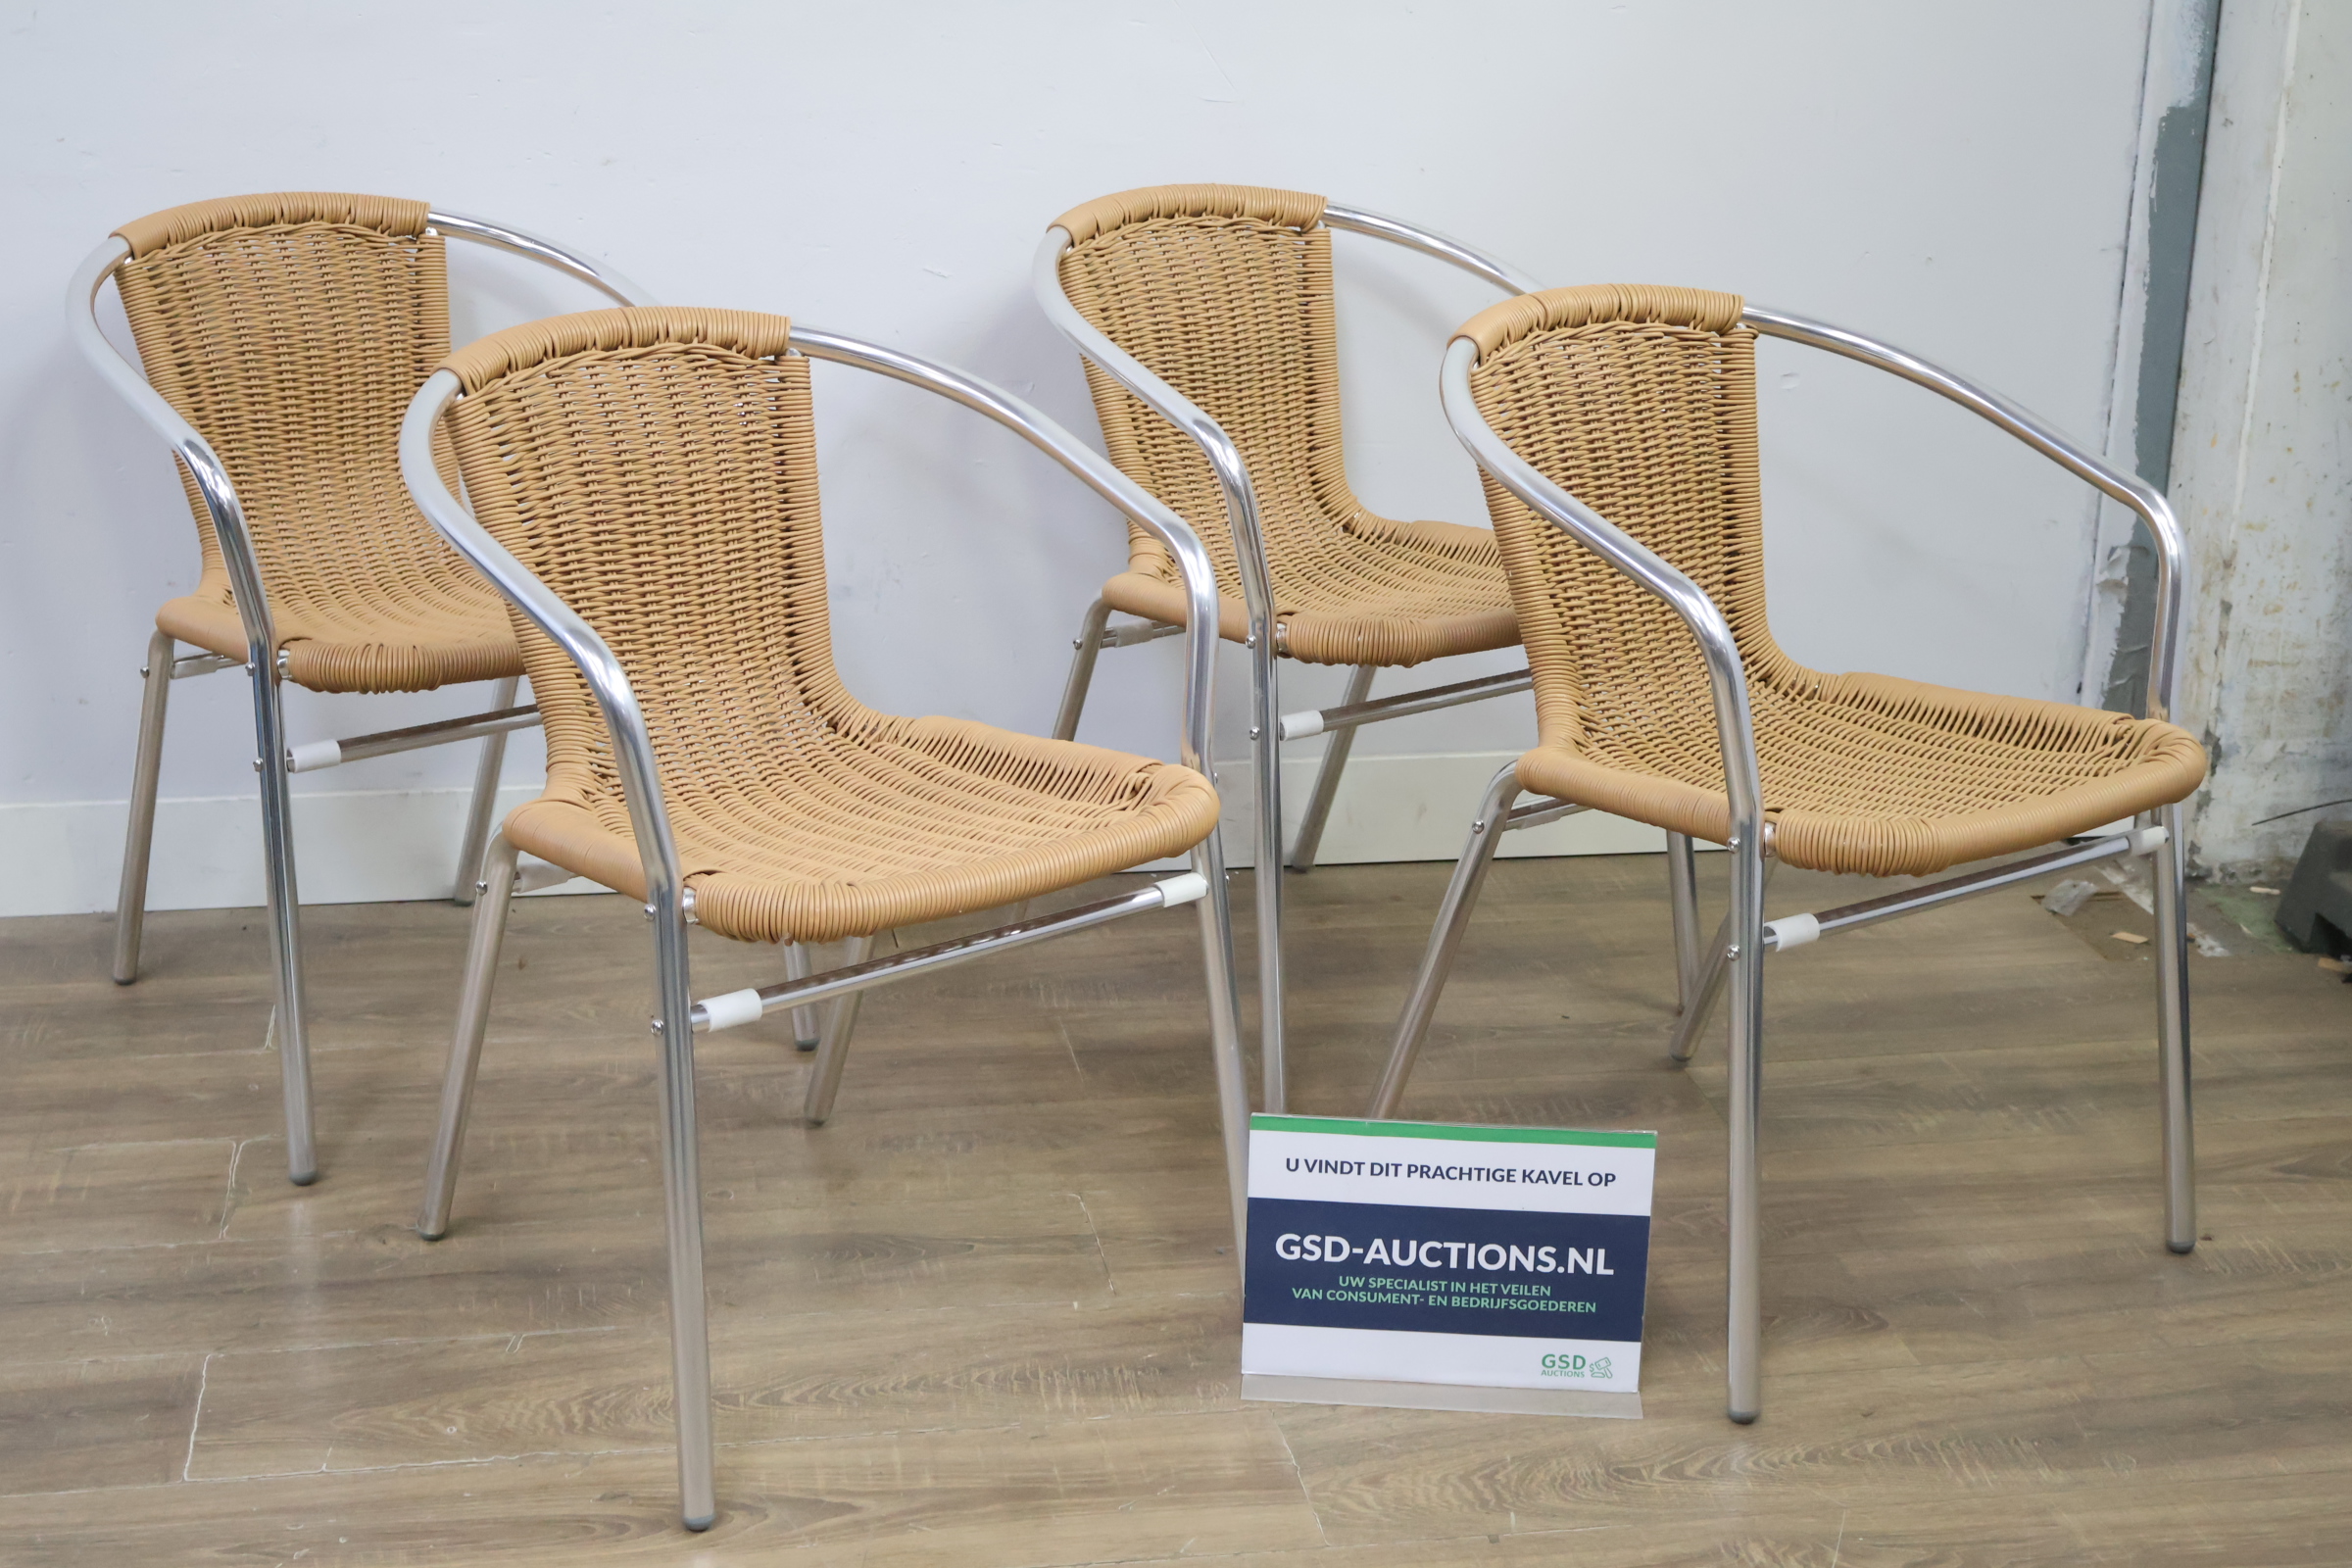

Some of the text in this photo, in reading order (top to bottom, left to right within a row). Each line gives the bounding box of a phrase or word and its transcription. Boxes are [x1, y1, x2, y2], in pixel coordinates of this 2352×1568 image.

[1286, 1157, 1617, 1187] U VINDT DIT PRACHTIGE KAVEL OP
[1275, 1233, 1615, 1275] GSD-AUCTIONS.NL
[1339, 1276, 1551, 1297] UW SPECIALIST IN HET VEILEN
[1292, 1288, 1596, 1313] VAN CONSUMENT- EN BEDRIJFSGOEDEREN
[1541, 1353, 1586, 1370] GSD
[1541, 1369, 1585, 1378] AUCTIONS
